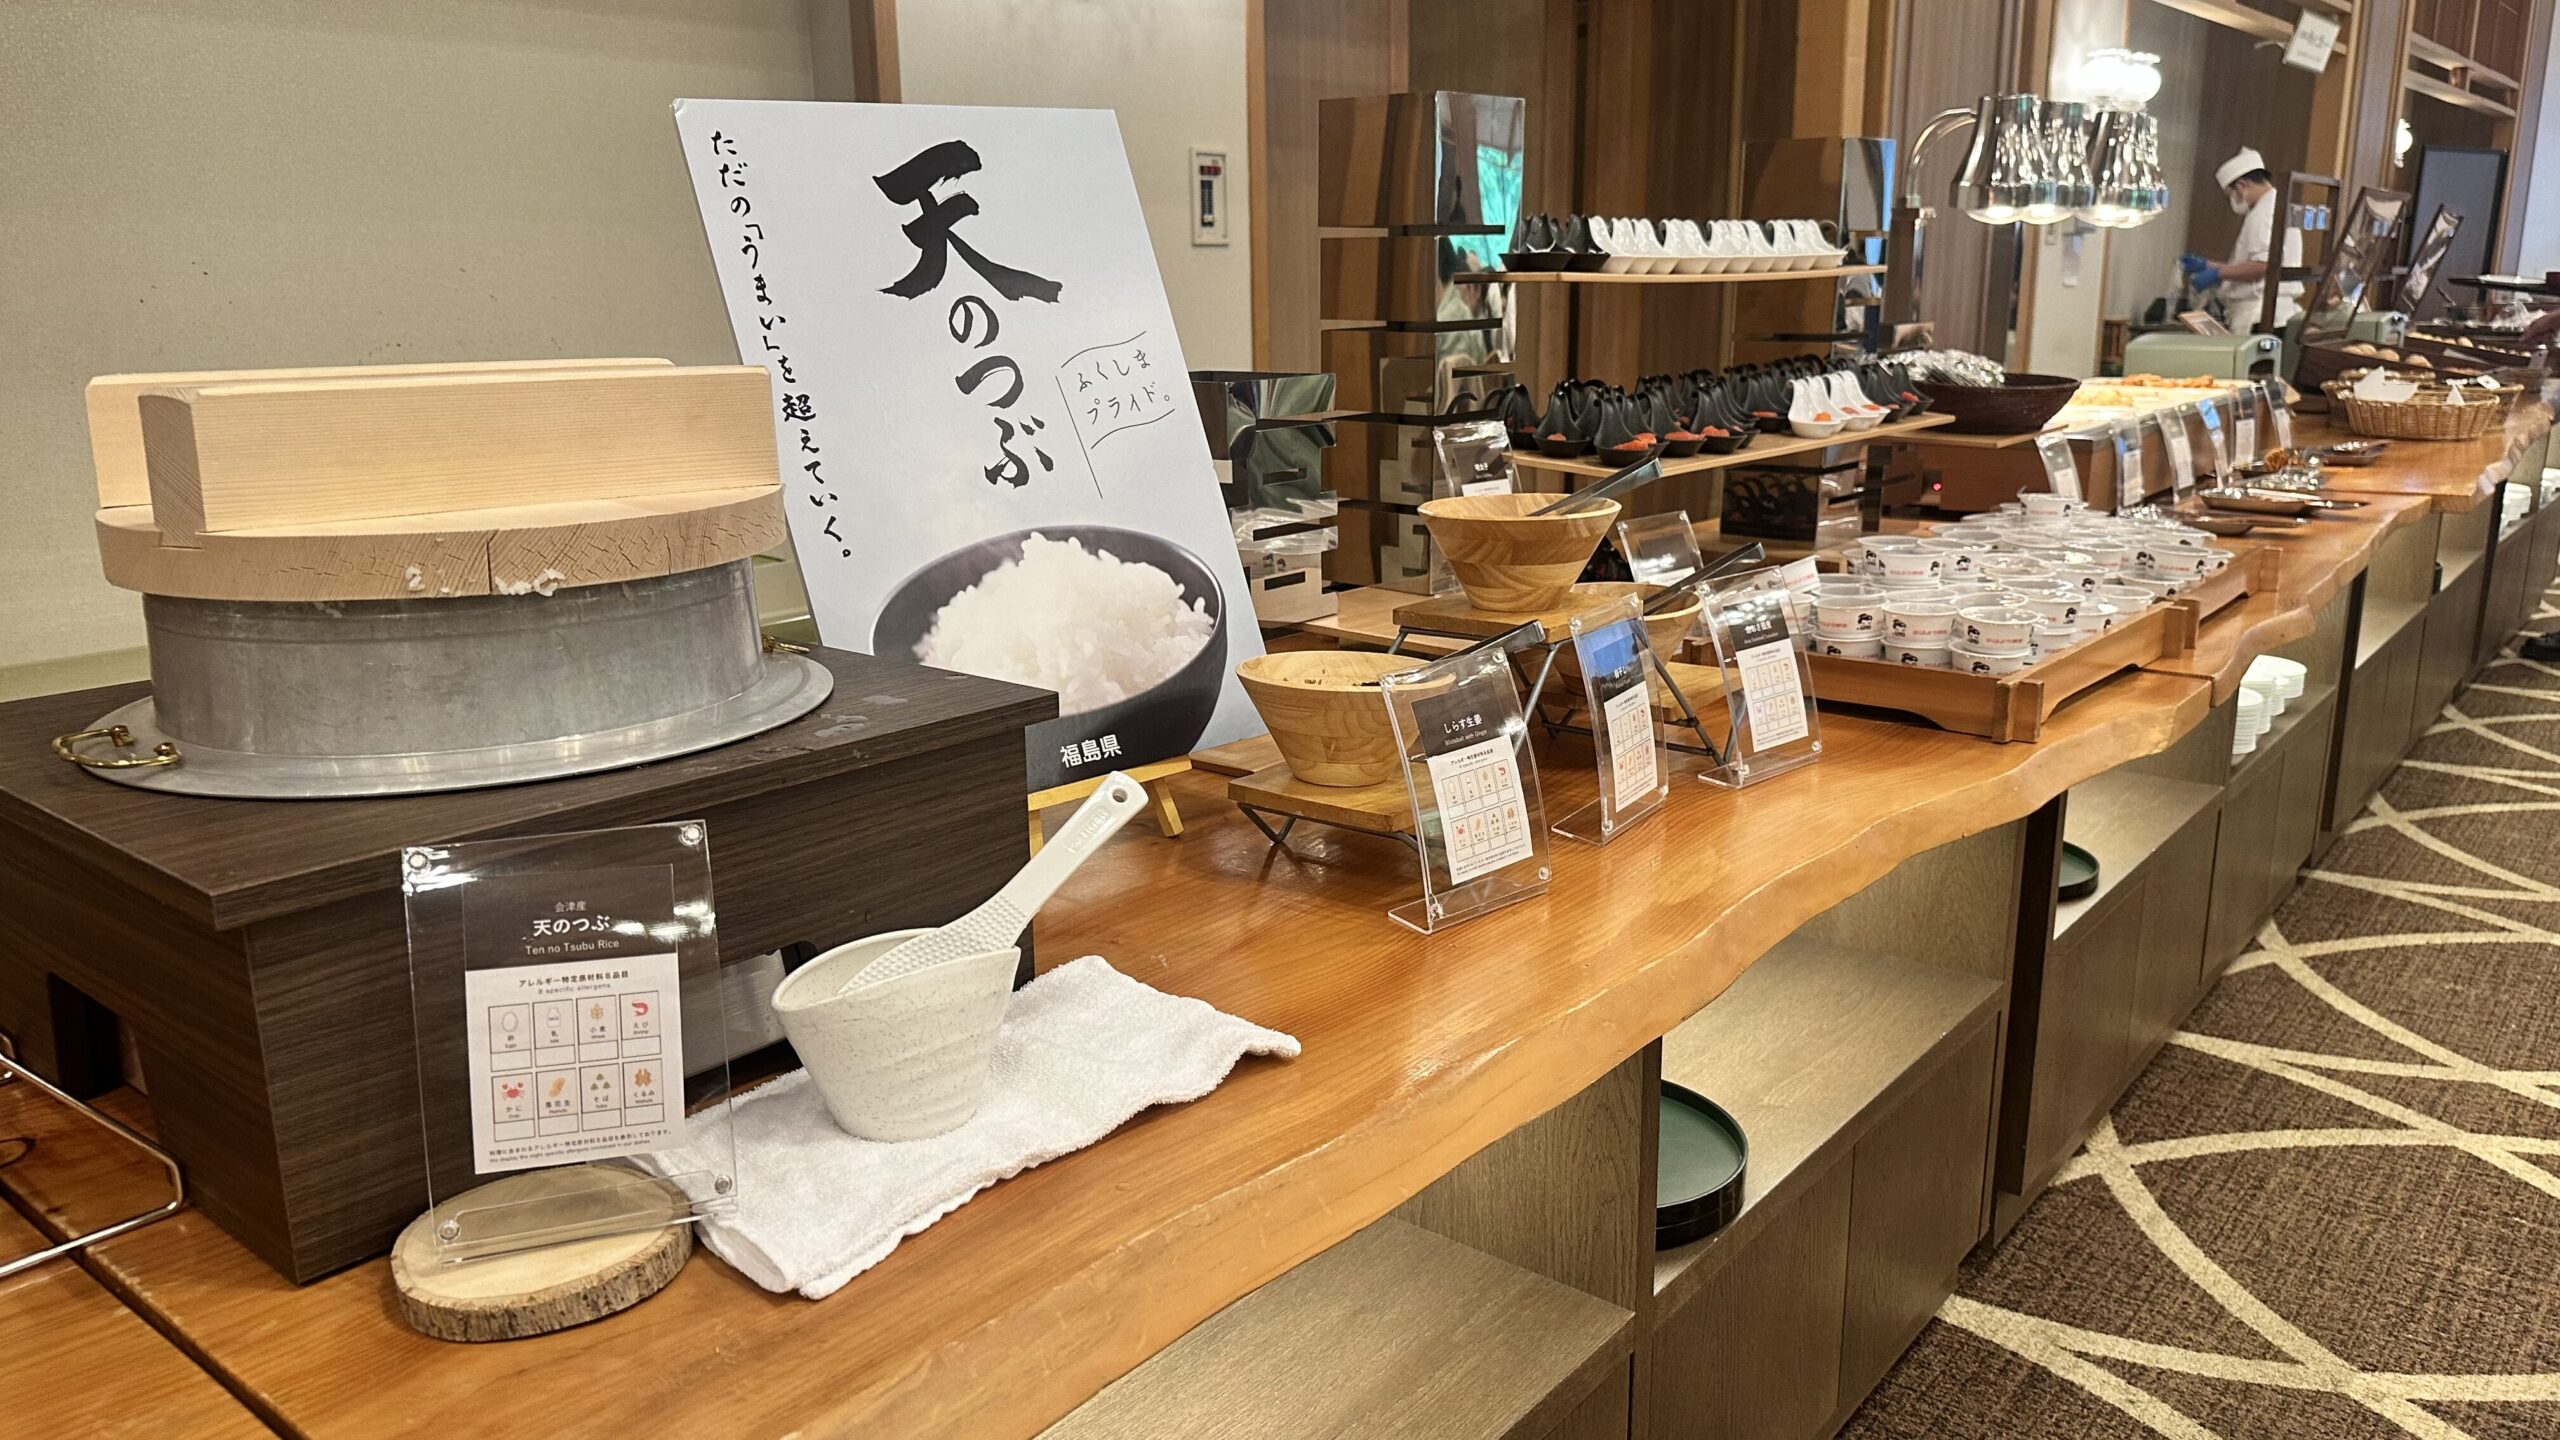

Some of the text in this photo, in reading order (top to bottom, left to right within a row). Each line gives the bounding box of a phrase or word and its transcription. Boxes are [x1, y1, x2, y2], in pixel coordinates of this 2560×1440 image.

[873, 139, 1063, 489] 天のつぶ
[711, 130, 852, 558] ただの「うまい」を超えていく。
[1078, 349, 1151, 392] ふくしま
[1087, 382, 1170, 425] プライド。
[1060, 734, 1122, 768] 福島県
[555, 901, 587, 912] 会津産
[533, 915, 610, 937] 天のつぶ
[525, 939, 619, 955] Ten no Tsubu Rice
